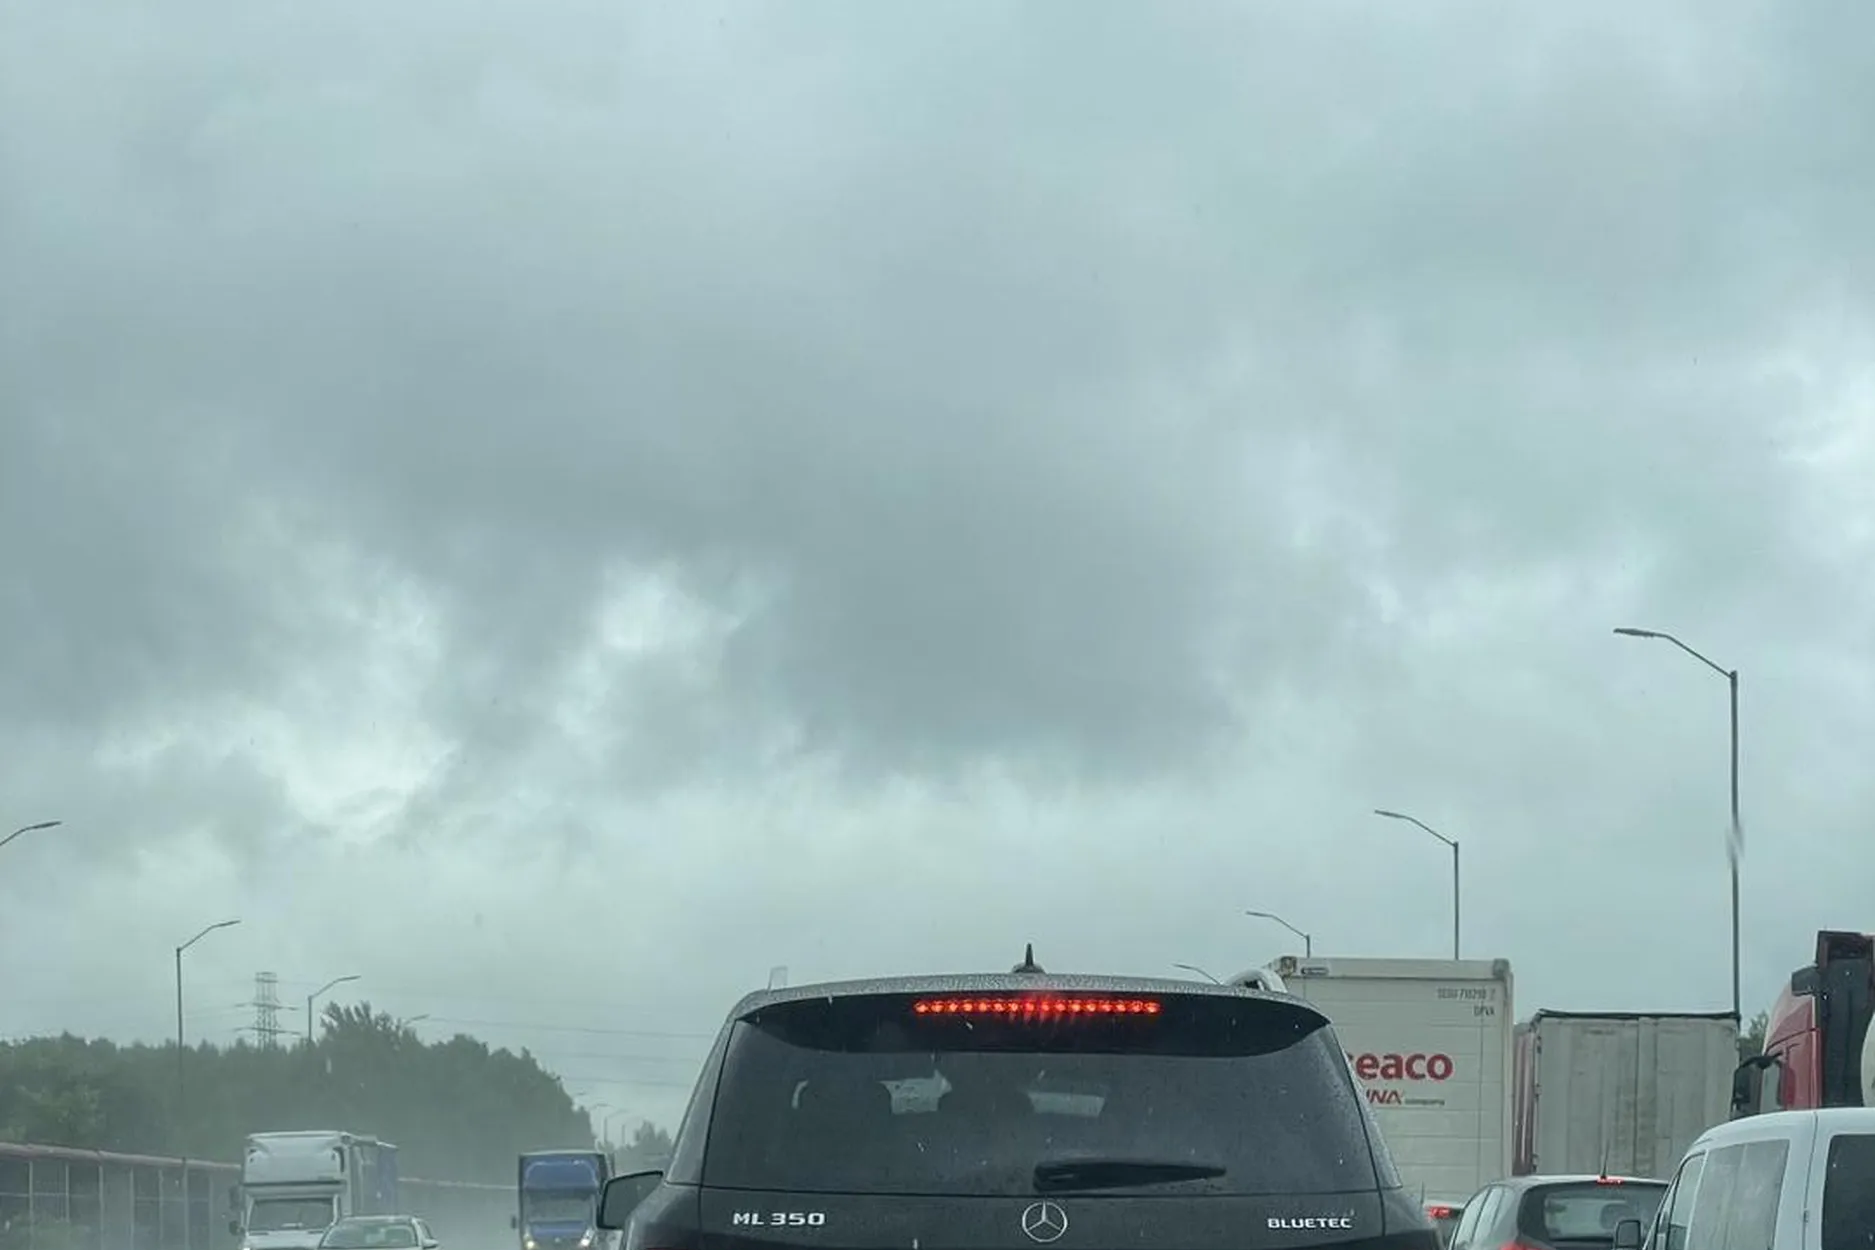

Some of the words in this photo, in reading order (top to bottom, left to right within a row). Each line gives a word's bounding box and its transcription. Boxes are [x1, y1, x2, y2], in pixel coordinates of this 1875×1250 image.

[733, 1212, 764, 1225] ML
[770, 1212, 825, 1226] 350
[1267, 1217, 1353, 1229] BLUETEC
